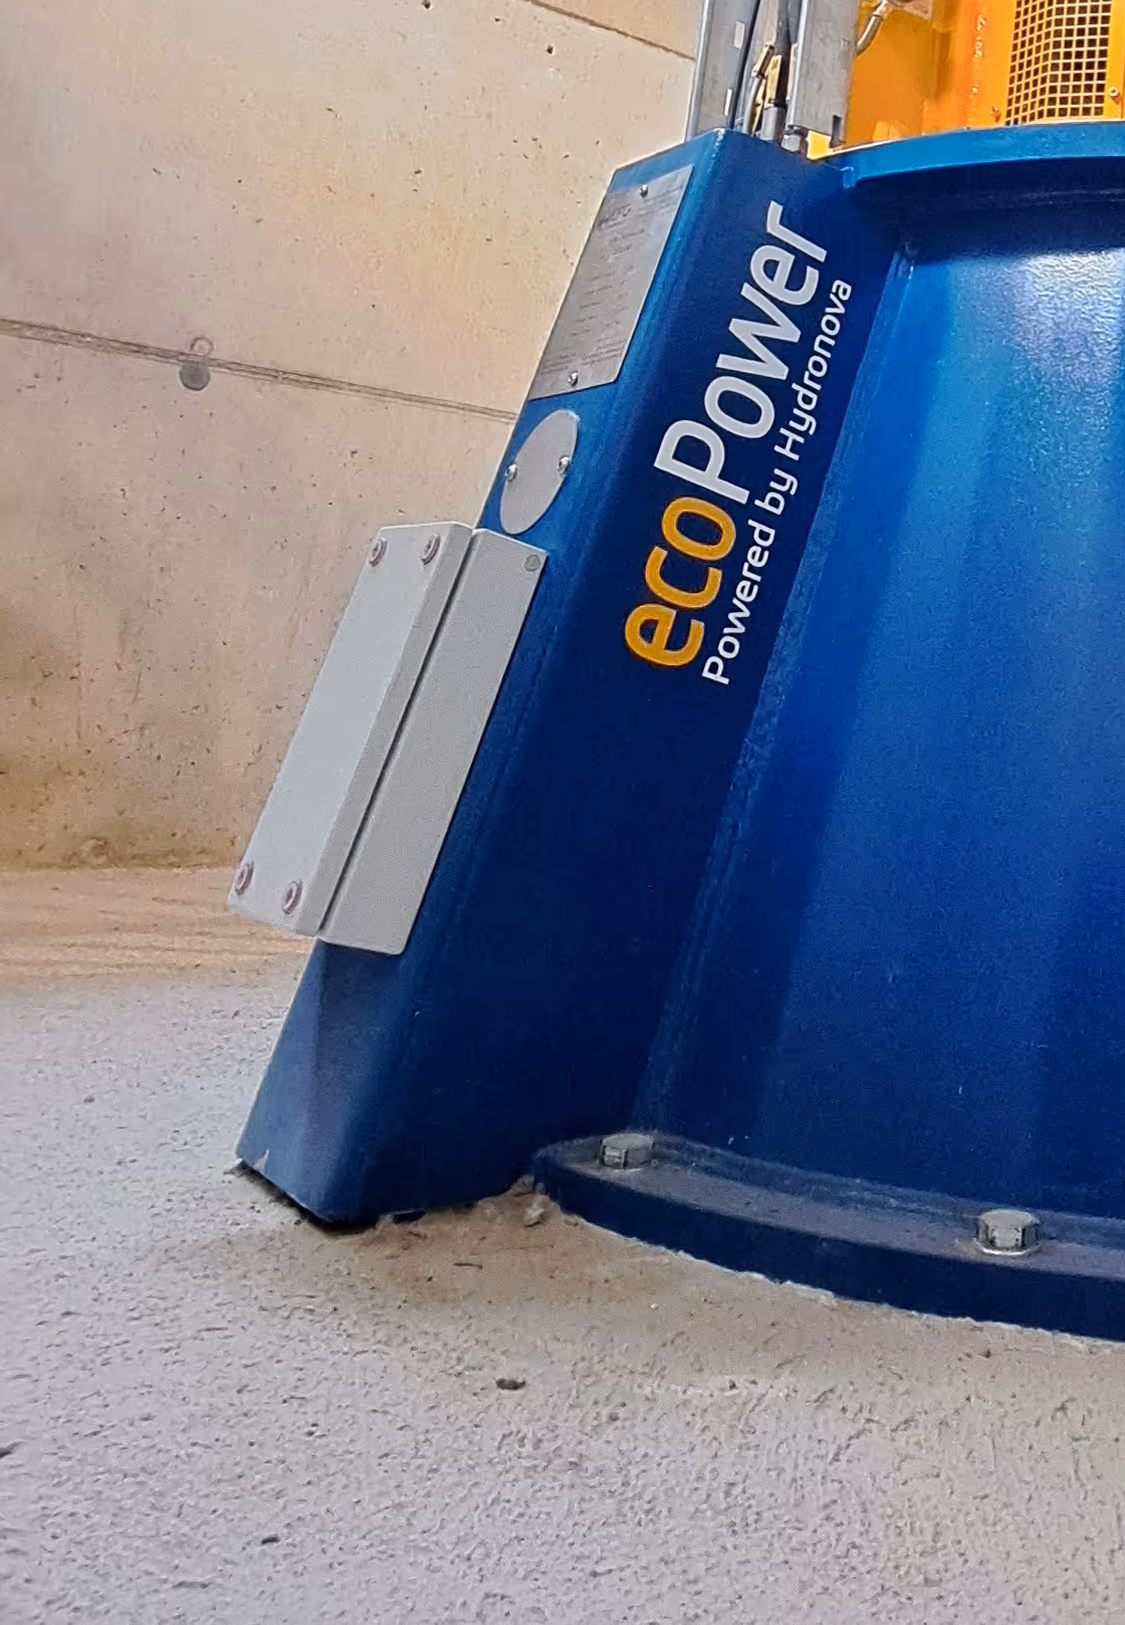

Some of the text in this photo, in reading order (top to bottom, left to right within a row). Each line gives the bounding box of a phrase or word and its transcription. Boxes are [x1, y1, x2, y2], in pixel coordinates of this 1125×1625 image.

[701, 279, 852, 685] Powered by Hydronova
